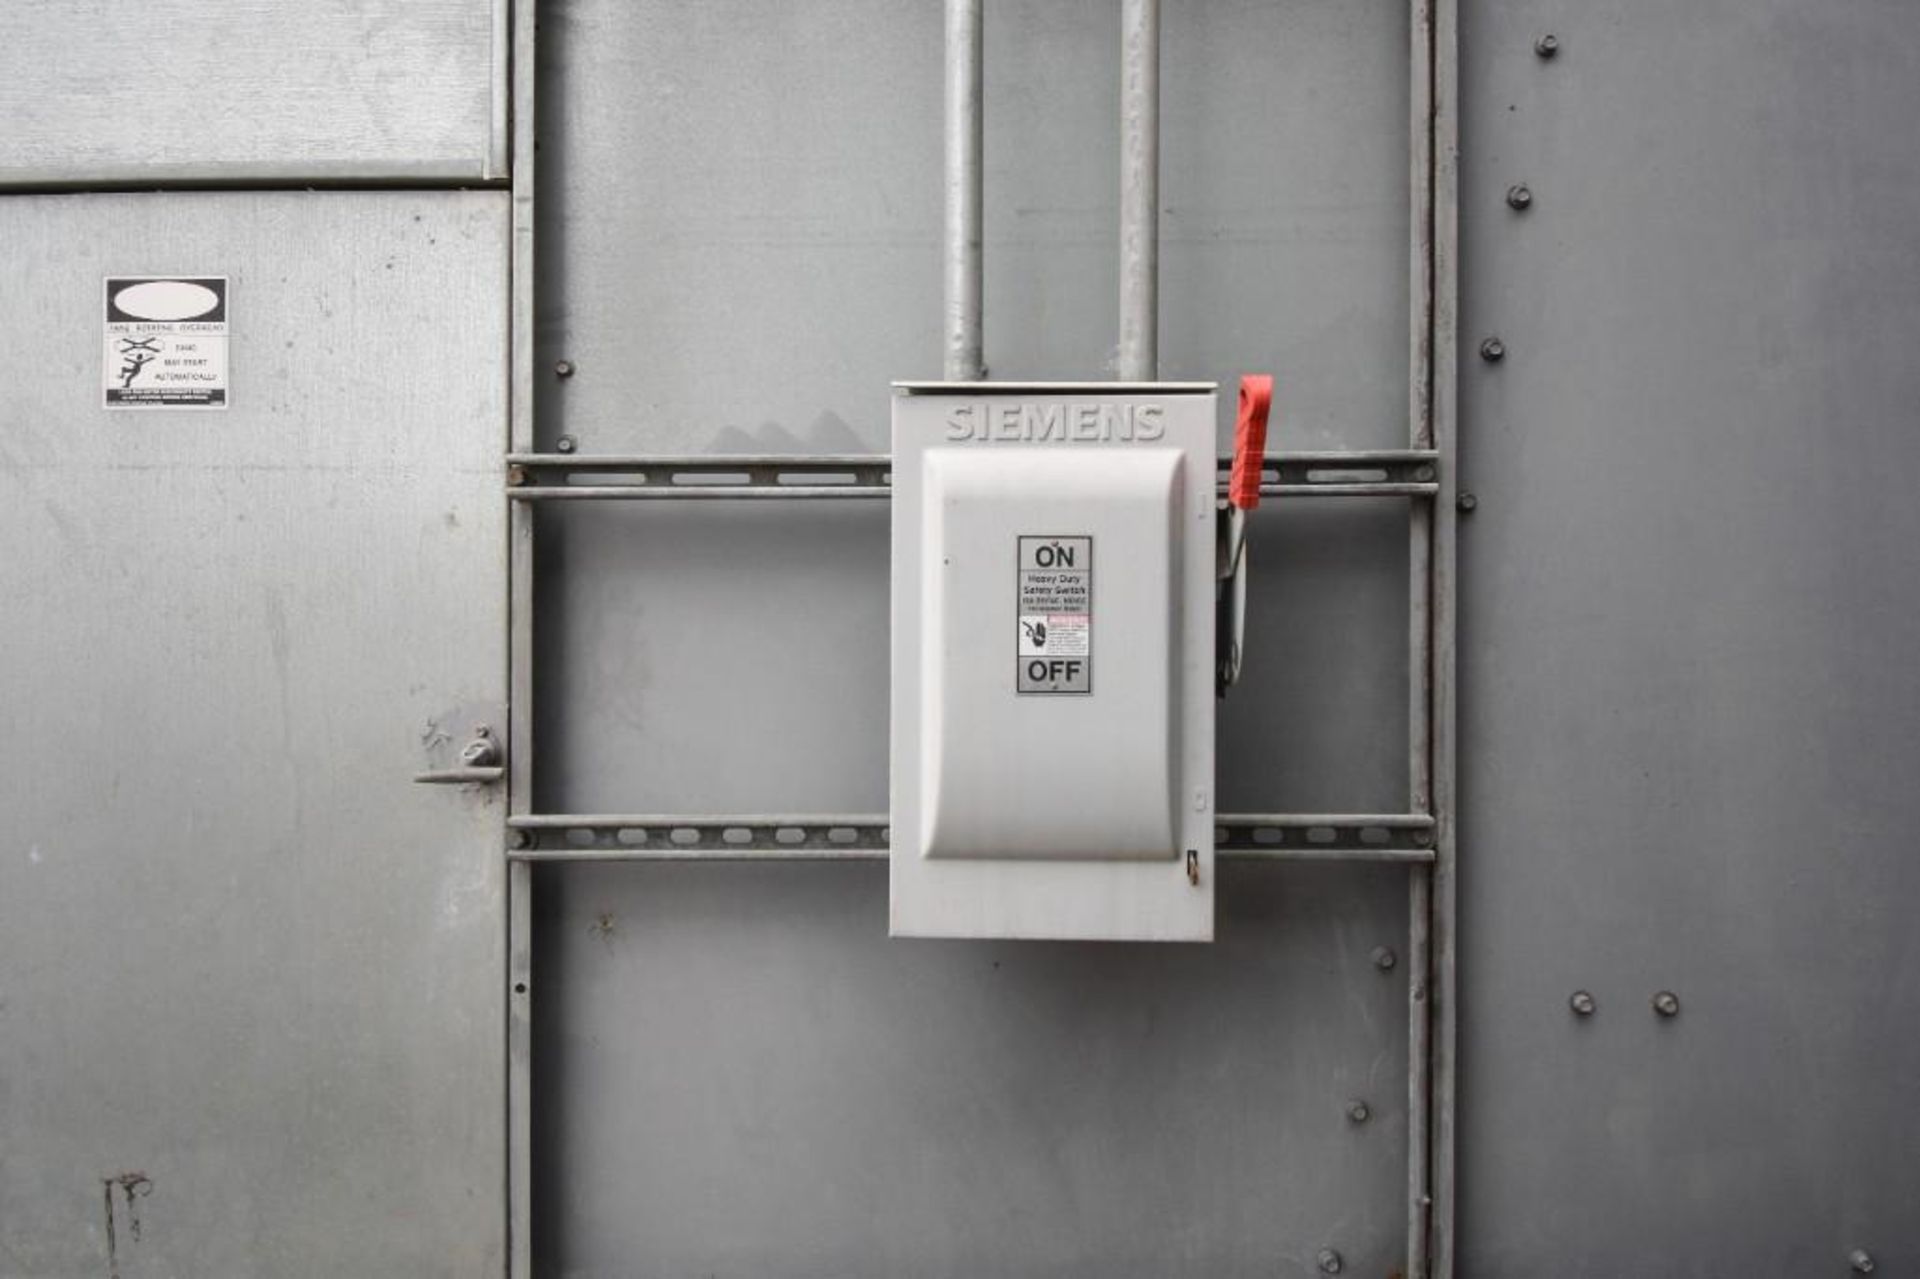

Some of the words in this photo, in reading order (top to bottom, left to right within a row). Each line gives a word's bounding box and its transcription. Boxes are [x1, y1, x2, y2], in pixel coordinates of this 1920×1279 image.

[947, 404, 1165, 441] SIEMENS
[1035, 546, 1074, 567] ON
[1028, 574, 1057, 584] Heavy
[1060, 574, 1080, 584] Duty
[1024, 586, 1053, 595] Safety
[1055, 586, 1086, 595] Switch
[1028, 660, 1082, 682] OFF
